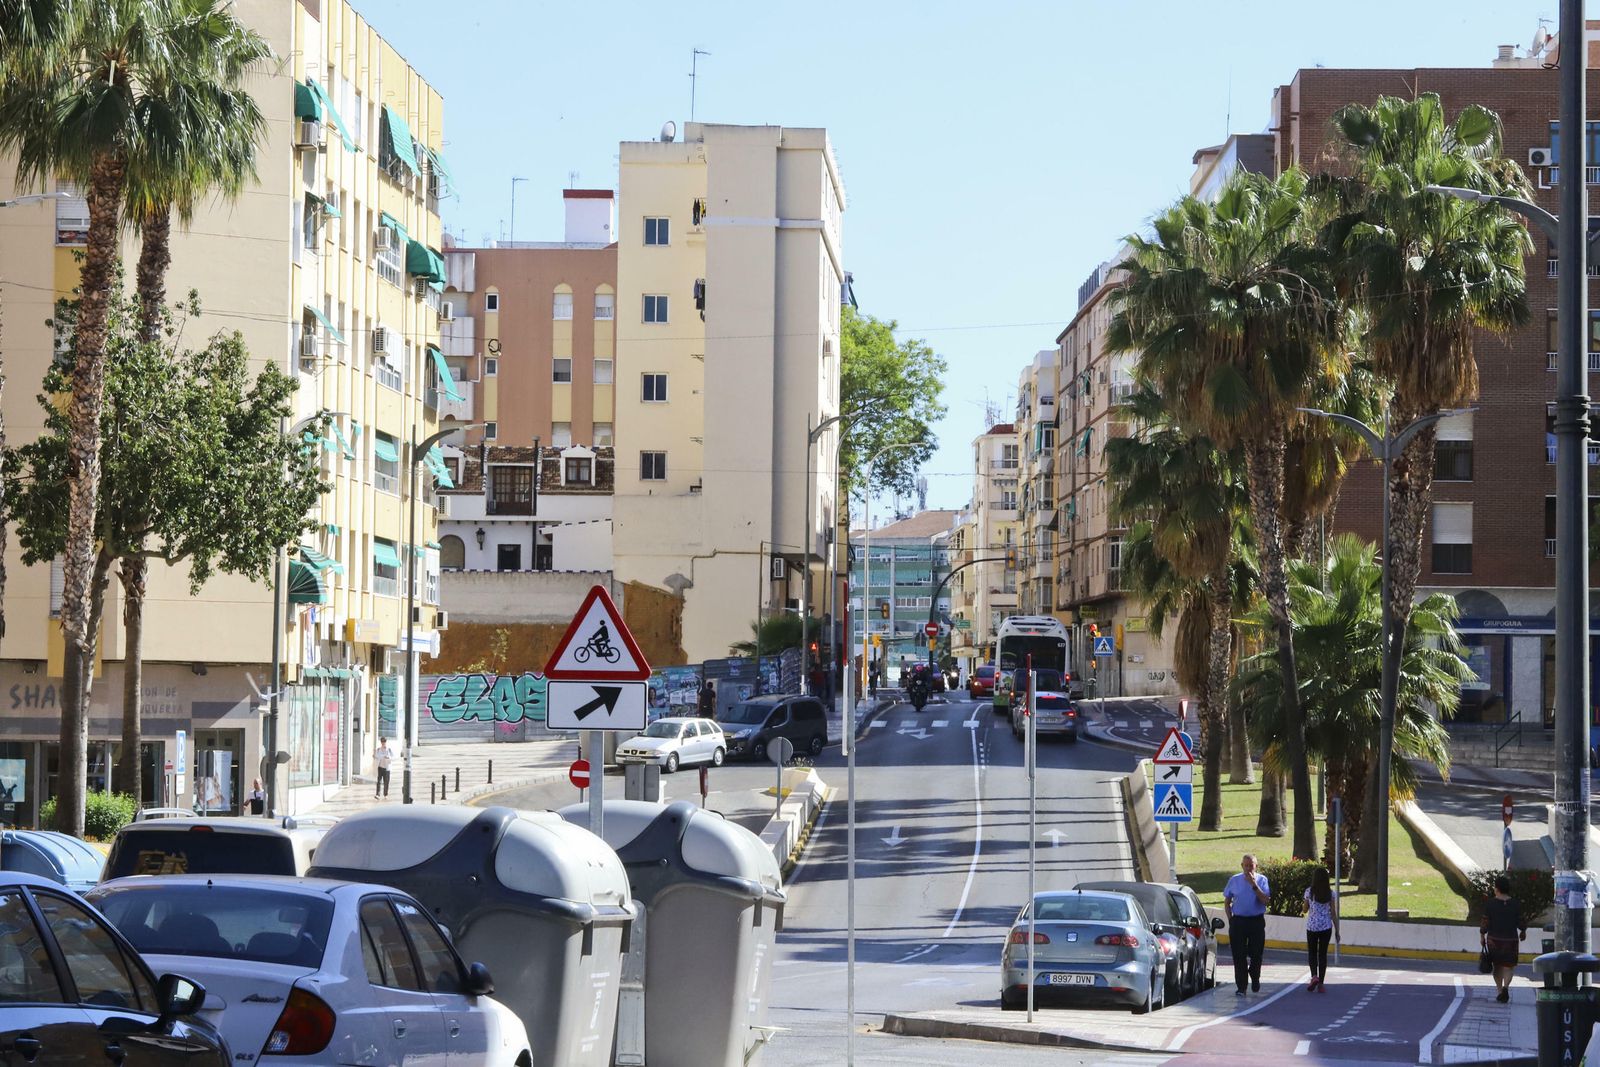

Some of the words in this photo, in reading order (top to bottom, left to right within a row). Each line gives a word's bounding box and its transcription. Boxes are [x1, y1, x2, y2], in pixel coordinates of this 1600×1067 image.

[9, 683, 62, 710] SHA
[165, 686, 177, 697] DE
[1052, 974, 1073, 984] 8997
[1075, 975, 1092, 984] DVN
